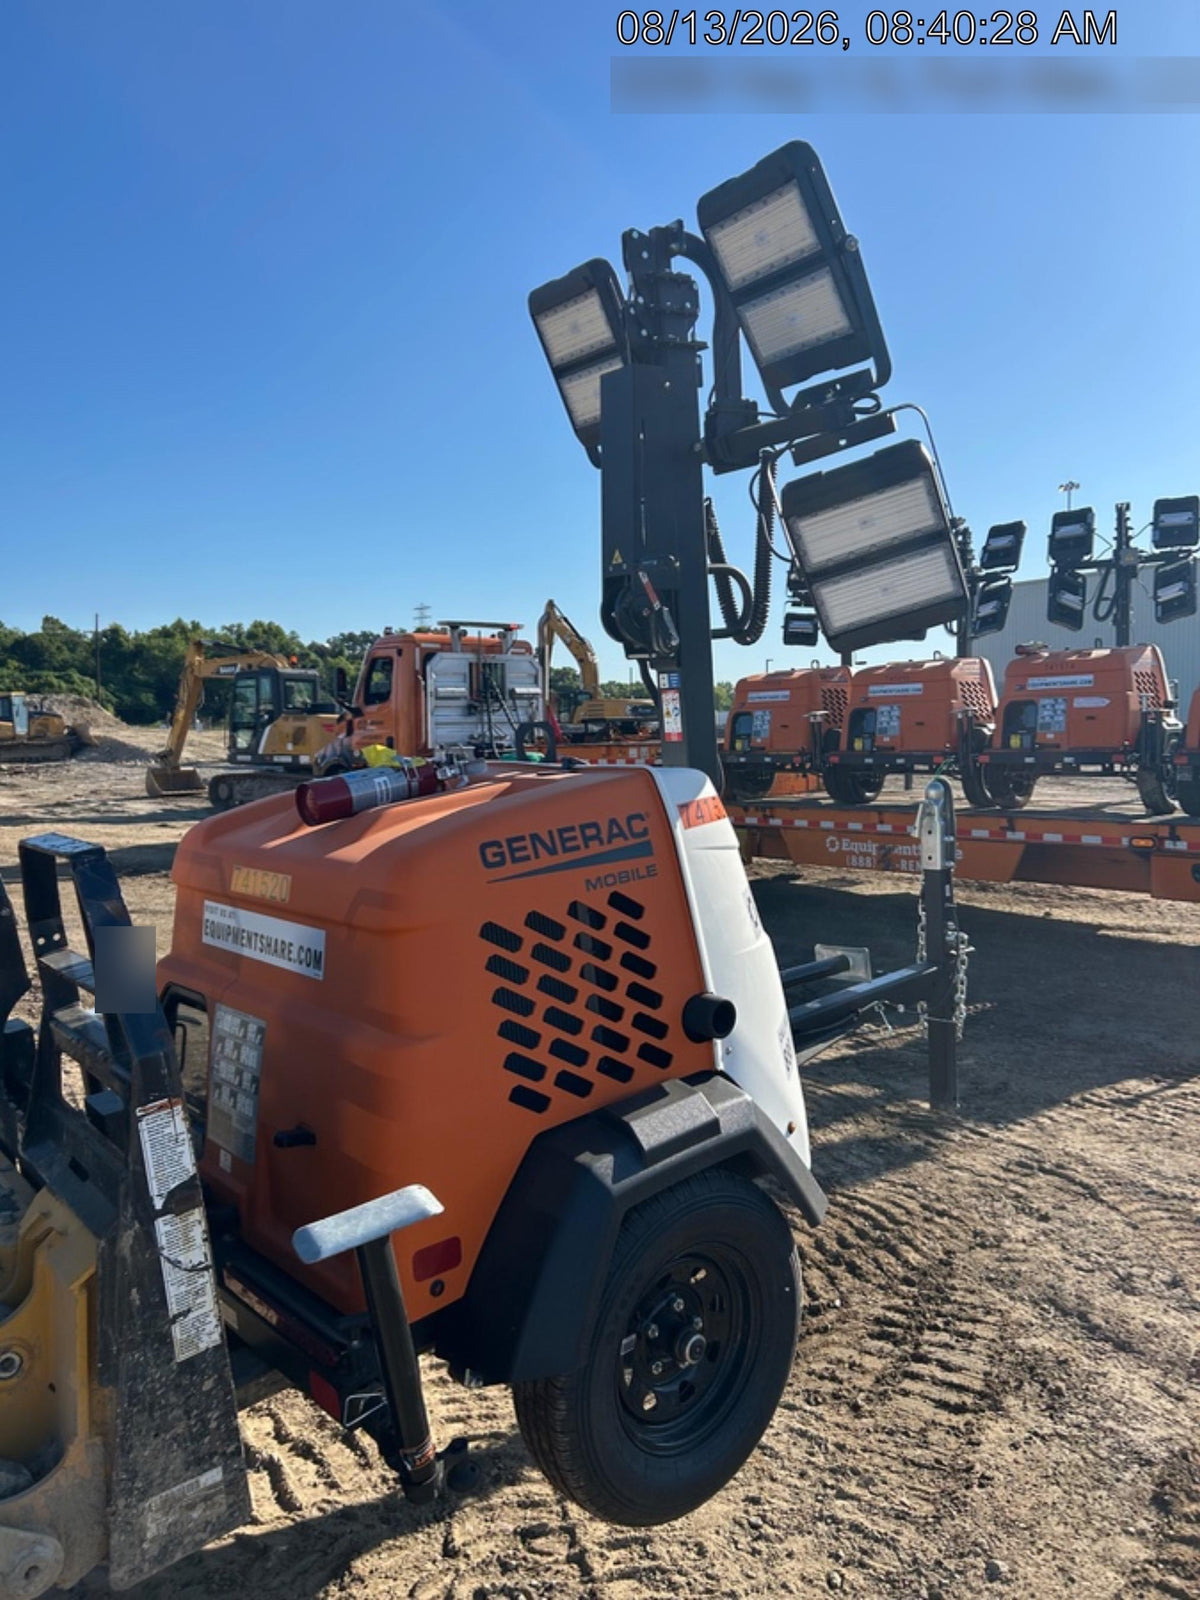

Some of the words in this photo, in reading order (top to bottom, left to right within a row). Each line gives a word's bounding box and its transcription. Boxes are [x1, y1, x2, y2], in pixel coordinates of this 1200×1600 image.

[478, 813, 649, 870] GENERAC
[232, 868, 289, 902] 741520
[585, 864, 659, 892] MOBILE
[204, 919, 323, 970] EQUIPMENTSHARE.COM
